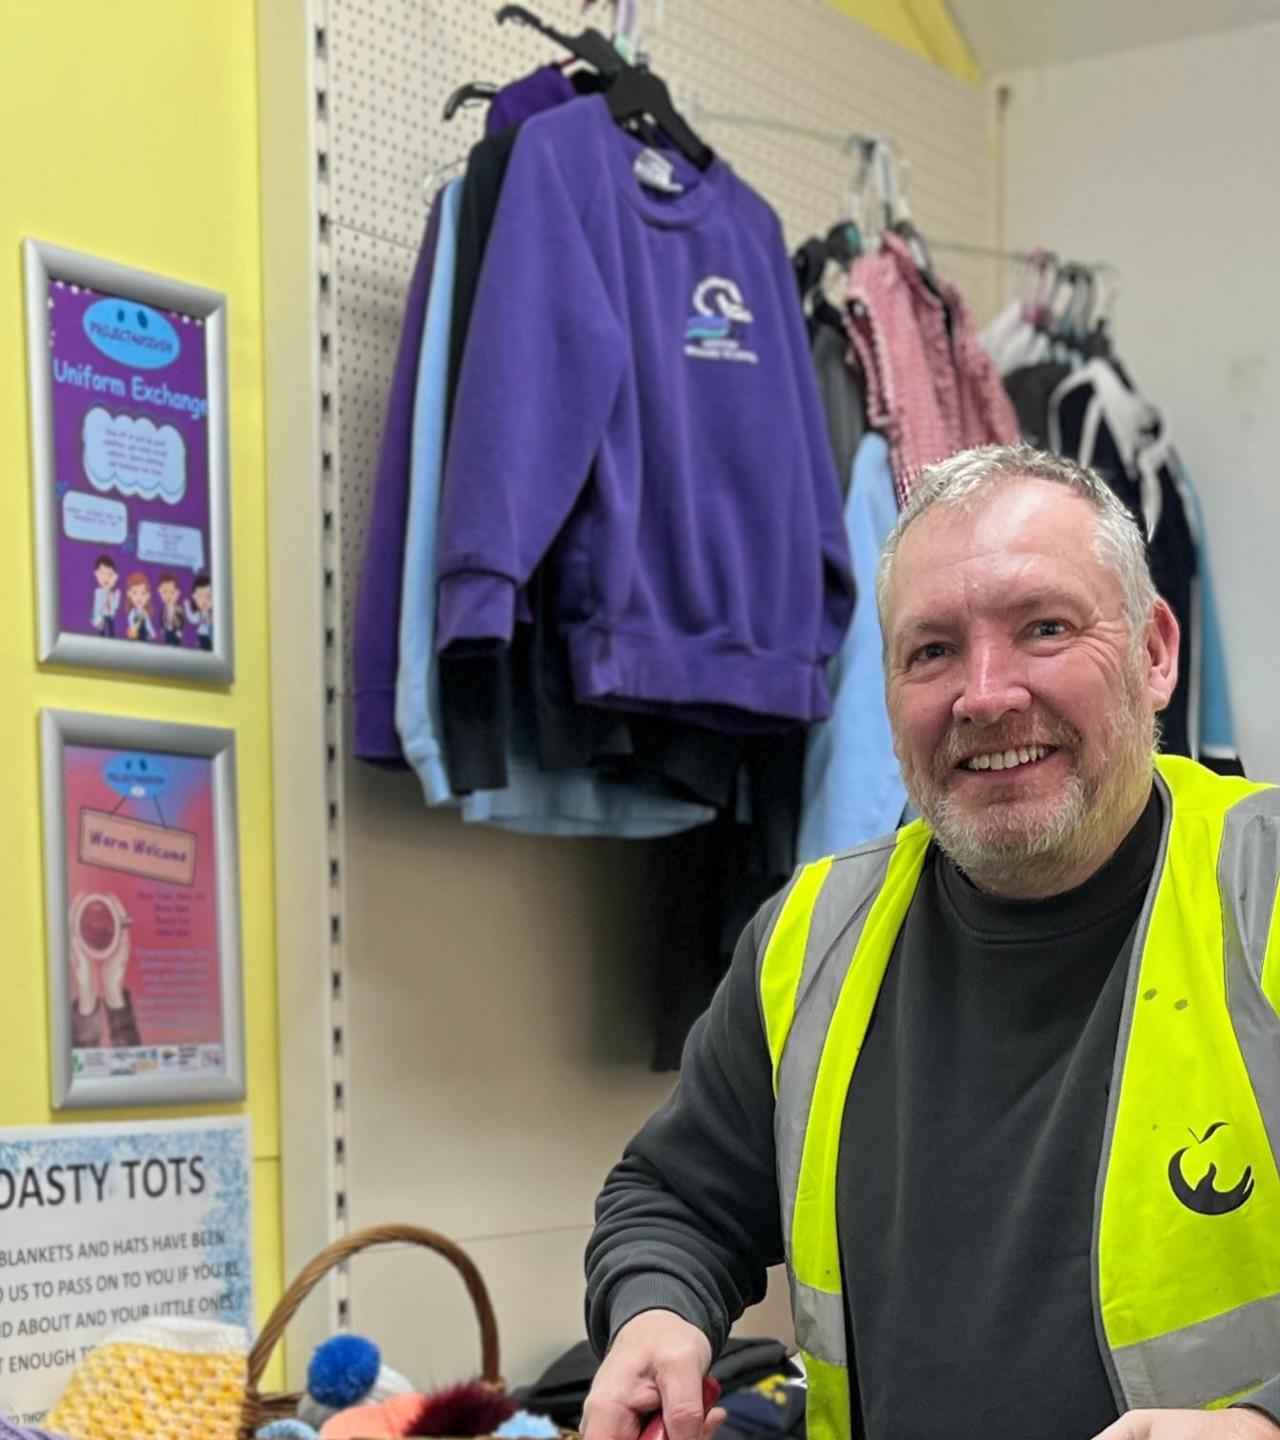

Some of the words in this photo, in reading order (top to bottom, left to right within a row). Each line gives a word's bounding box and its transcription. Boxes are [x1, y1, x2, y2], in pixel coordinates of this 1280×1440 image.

[53, 358, 125, 398] Uniform
[89, 829, 128, 850] Warm
[133, 837, 186, 863] Welcome
[121, 1155, 206, 1200] TOTS
[77, 1240, 110, 1259] AND
[114, 1236, 148, 1255] HATS
[152, 1232, 188, 1250] HAVE
[192, 1230, 225, 1248] BEEN
[9, 1283, 29, 1302] US
[33, 1280, 54, 1299] TO
[58, 1275, 93, 1296] PASS
[96, 1273, 119, 1292] ON
[122, 1271, 142, 1288] TO
[145, 1268, 174, 1285] YOU
[178, 1265, 189, 1282] IF
[17, 1313, 71, 1337] ABOUT
[75, 1309, 107, 1329] AND
[110, 1303, 150, 1324] YOUR
[198, 1293, 235, 1313] ONES
[9, 1349, 76, 1373] ENOUGH
